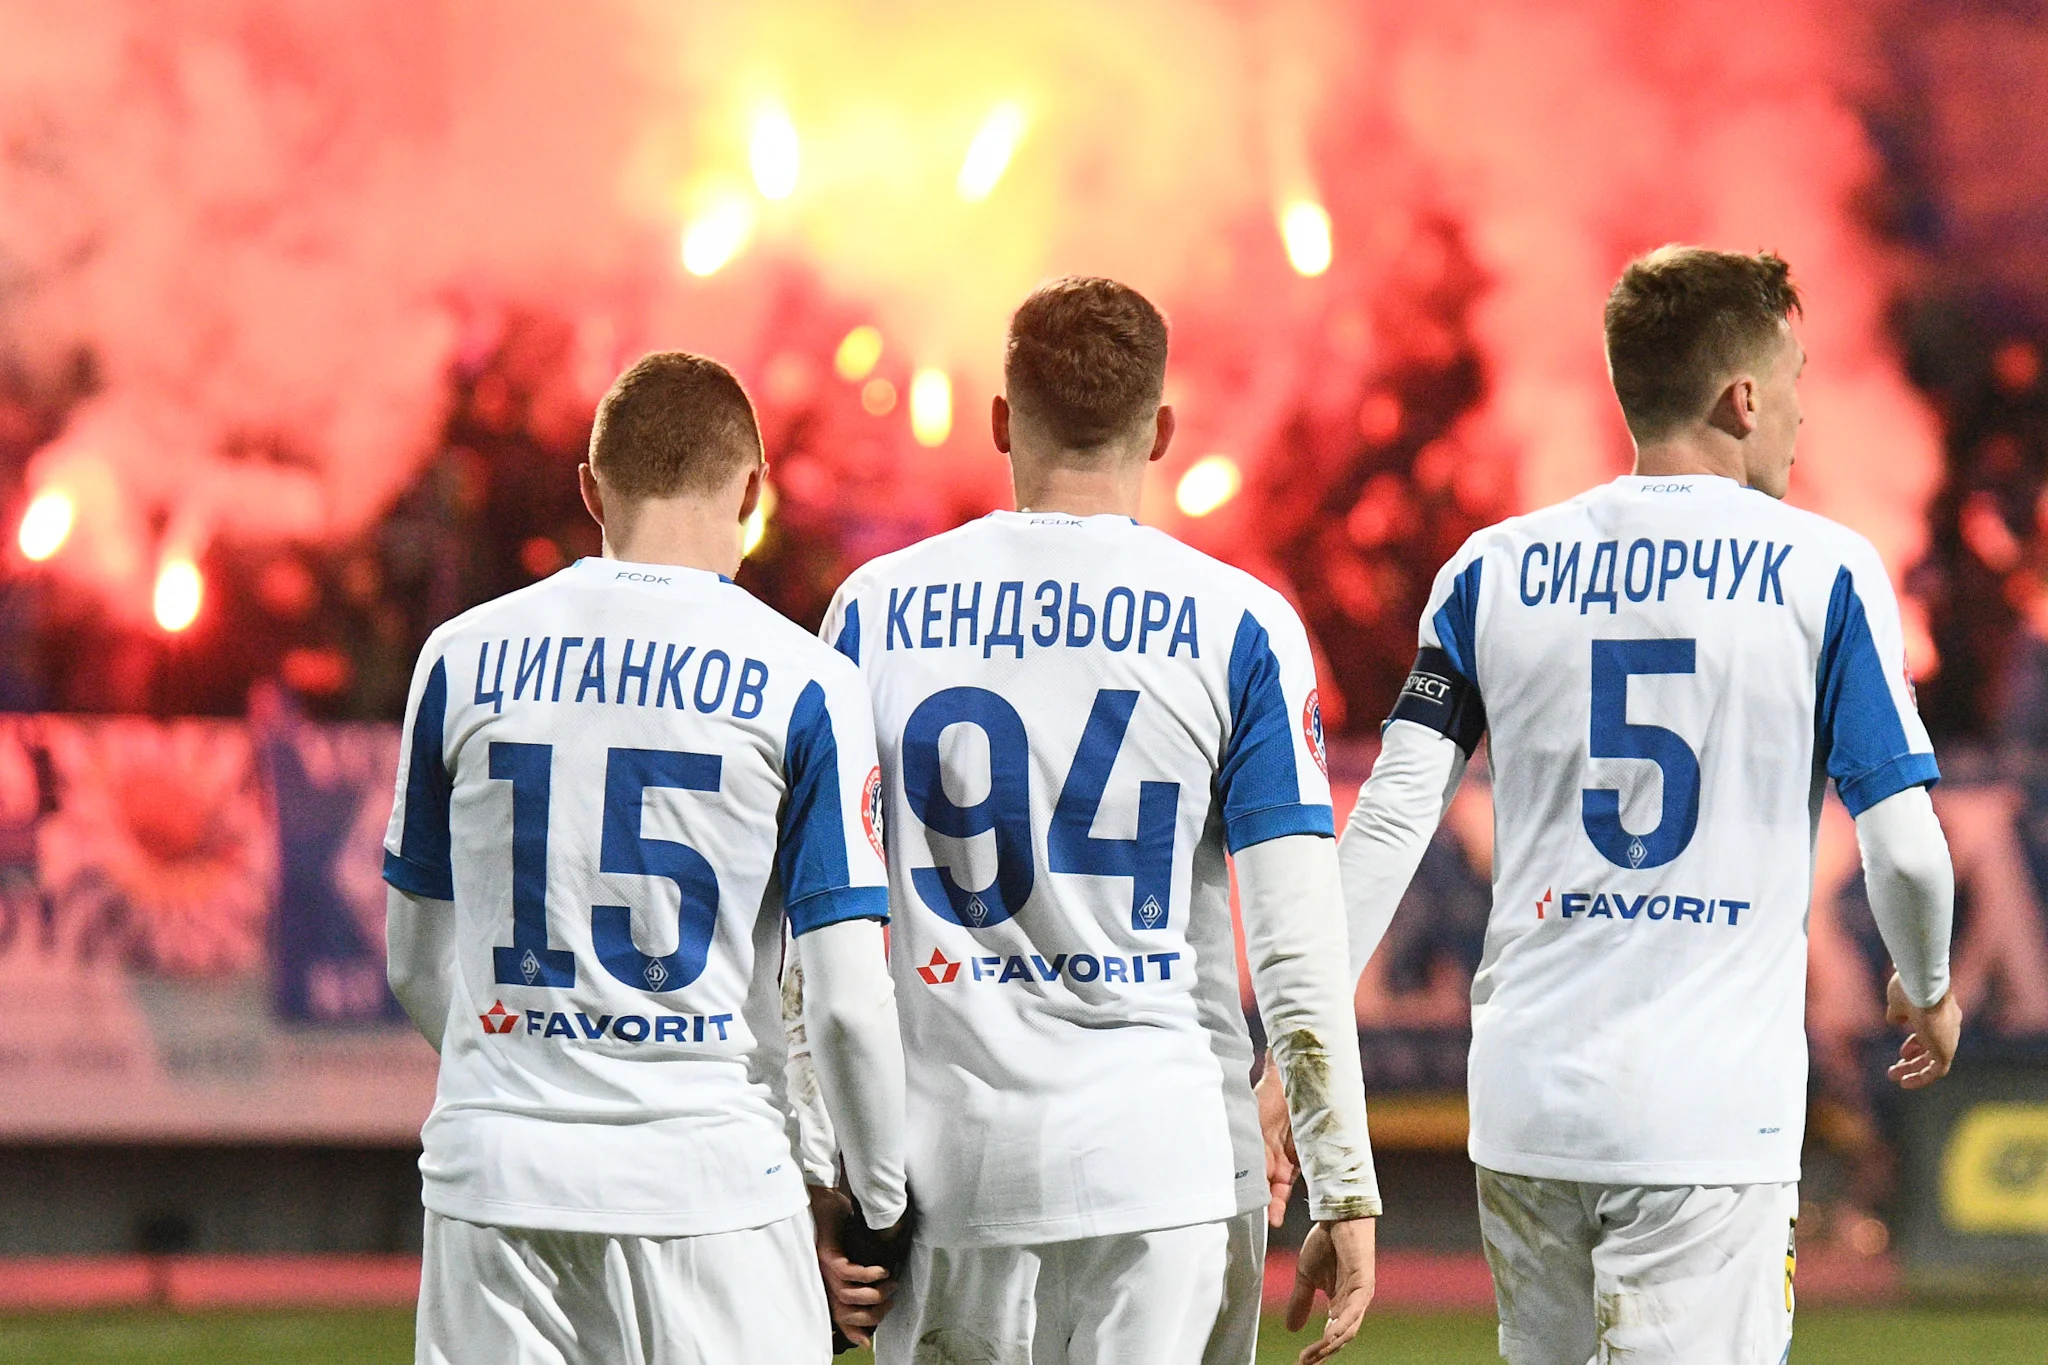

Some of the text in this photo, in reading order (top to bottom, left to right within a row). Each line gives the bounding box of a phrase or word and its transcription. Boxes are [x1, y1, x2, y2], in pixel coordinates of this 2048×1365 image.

[1640, 483, 1694, 494] FCDK
[1029, 518, 1083, 528] FCDK
[614, 571, 672, 585] FCDK
[1519, 537, 1793, 615] СИДОРЧУК
[886, 580, 1200, 659] КЕНДЗЬОРА
[474, 636, 770, 720] ЦИГАНКОВ
[1581, 637, 1700, 870] 5
[902, 685, 1181, 931] 94
[488, 741, 724, 993] 15
[1561, 893, 1751, 927] FAVORIT
[973, 951, 1181, 984] FAVORIT
[526, 1010, 734, 1043] FAVORIT
